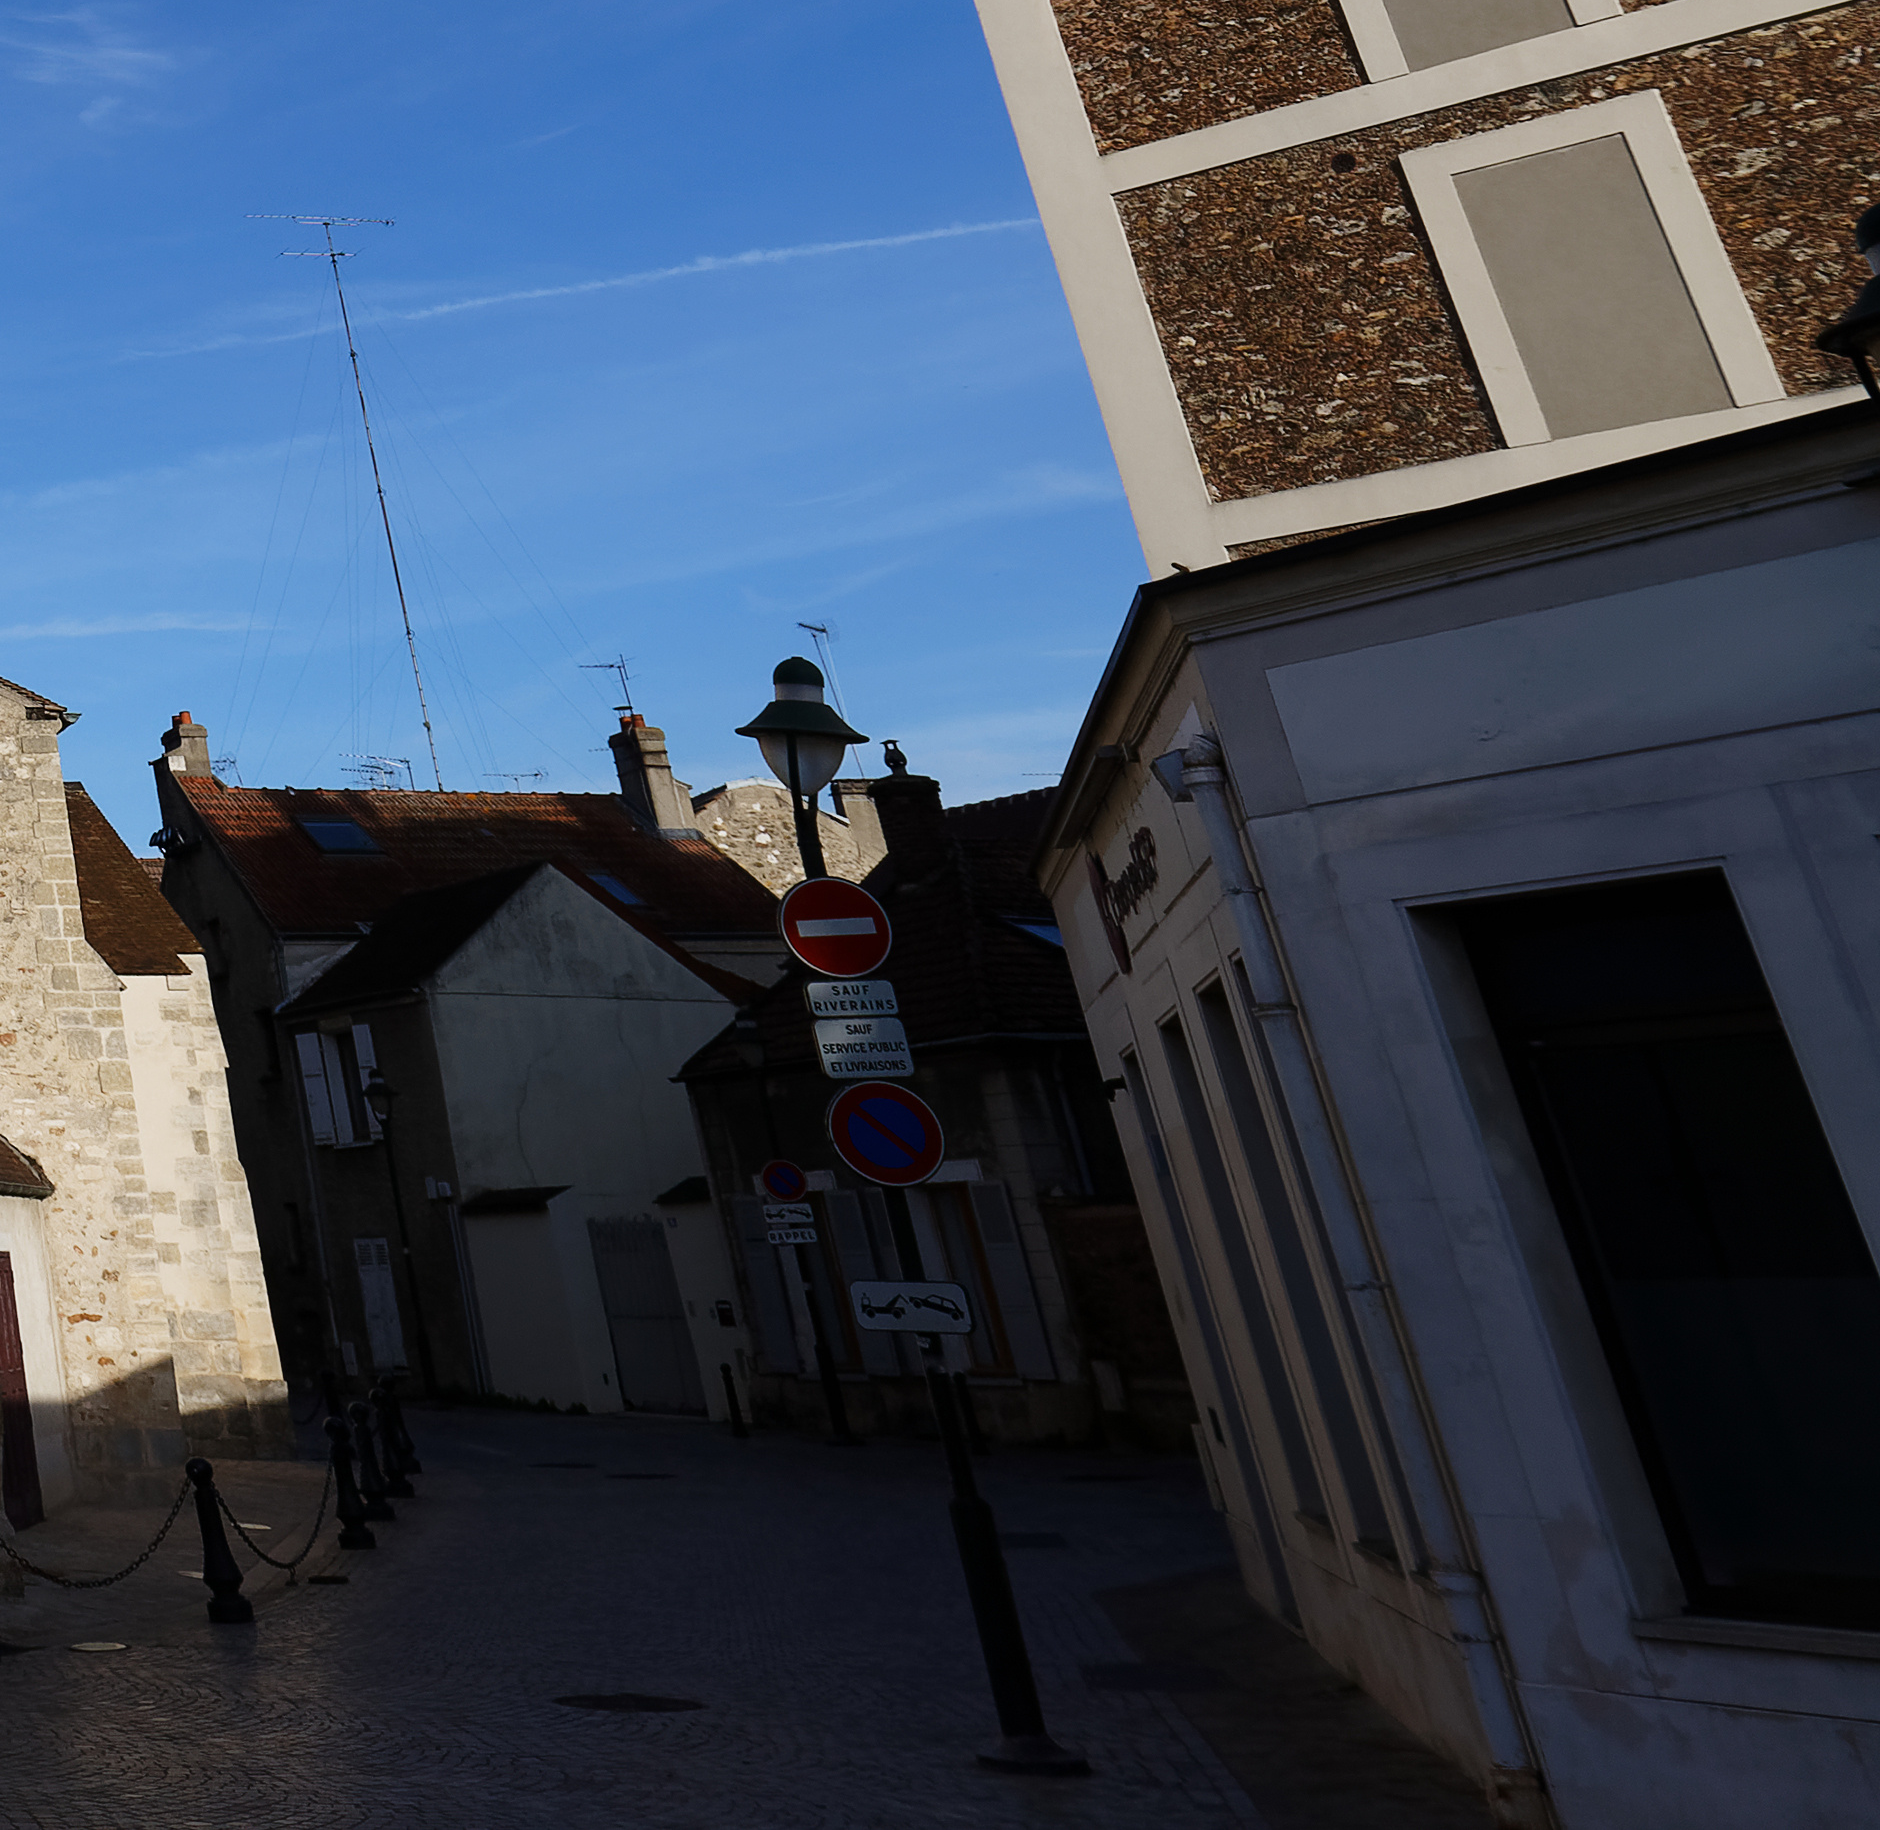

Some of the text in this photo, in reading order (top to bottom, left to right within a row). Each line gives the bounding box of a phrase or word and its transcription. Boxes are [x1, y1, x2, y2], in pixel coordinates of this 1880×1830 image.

[831, 985, 869, 995] SAUF
[813, 999, 895, 1012] RIVERAINS
[845, 1024, 872, 1035] SAUF
[822, 1042, 906, 1054] SERVICE PUBLIC
[830, 1060, 907, 1072] ET LIVRAISONS
[769, 1231, 816, 1241] RAPPEL
